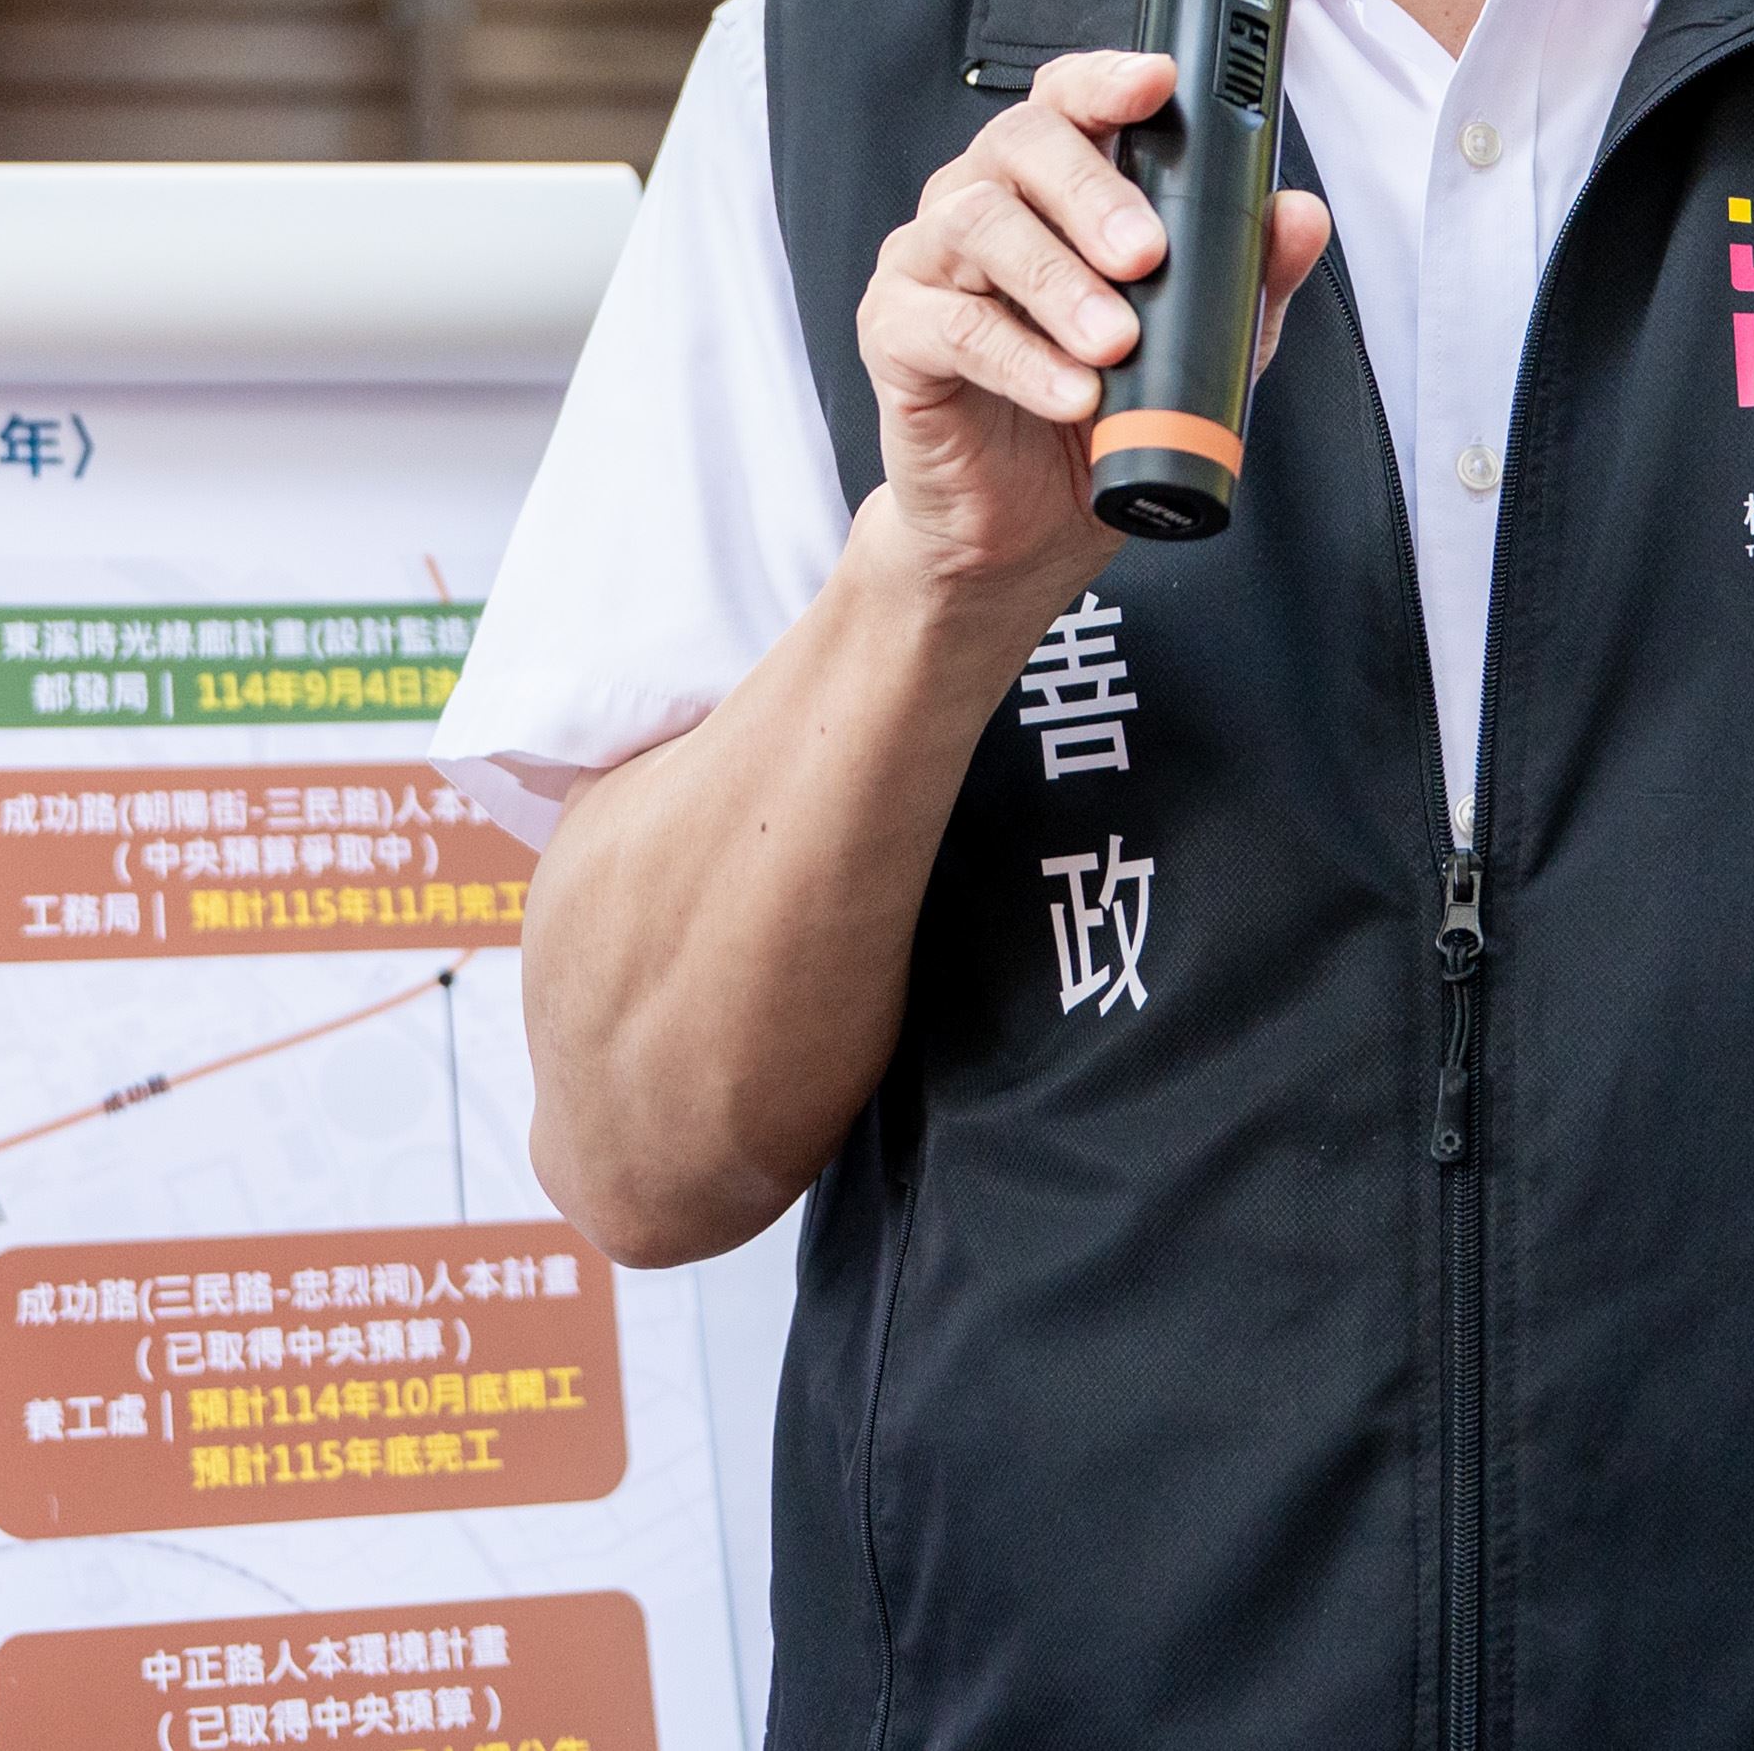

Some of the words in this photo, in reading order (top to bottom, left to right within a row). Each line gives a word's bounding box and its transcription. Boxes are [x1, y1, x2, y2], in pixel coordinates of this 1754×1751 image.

[21, 892, 140, 937] 工務局
[1019, 591, 1155, 1017] 善政
